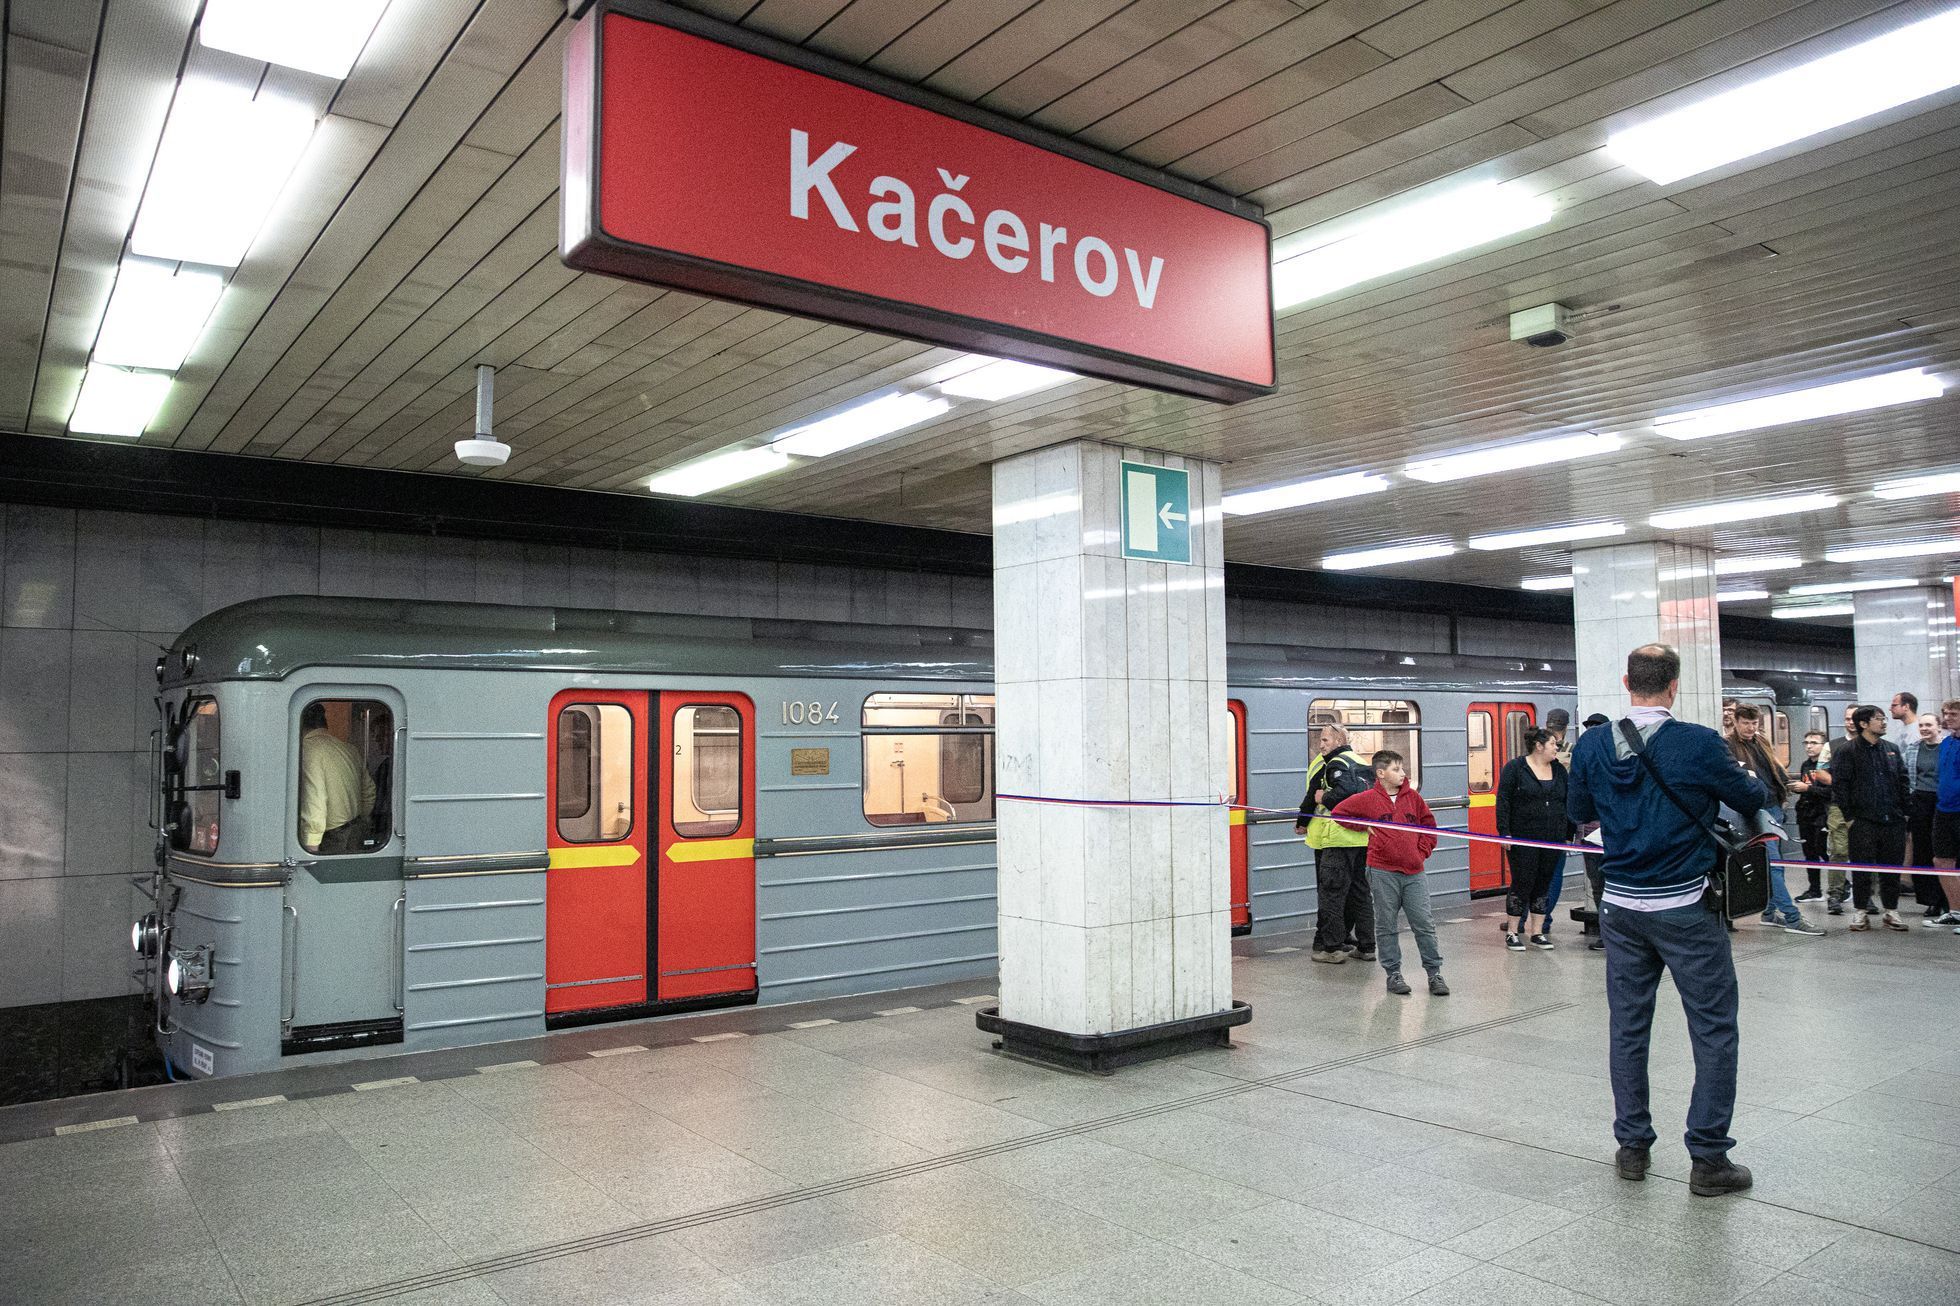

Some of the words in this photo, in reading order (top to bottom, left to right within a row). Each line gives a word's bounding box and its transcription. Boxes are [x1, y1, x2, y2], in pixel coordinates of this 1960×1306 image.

[790, 128, 1164, 309] Kačerov
[782, 701, 839, 725] 1084
[675, 744, 682, 755] 2
